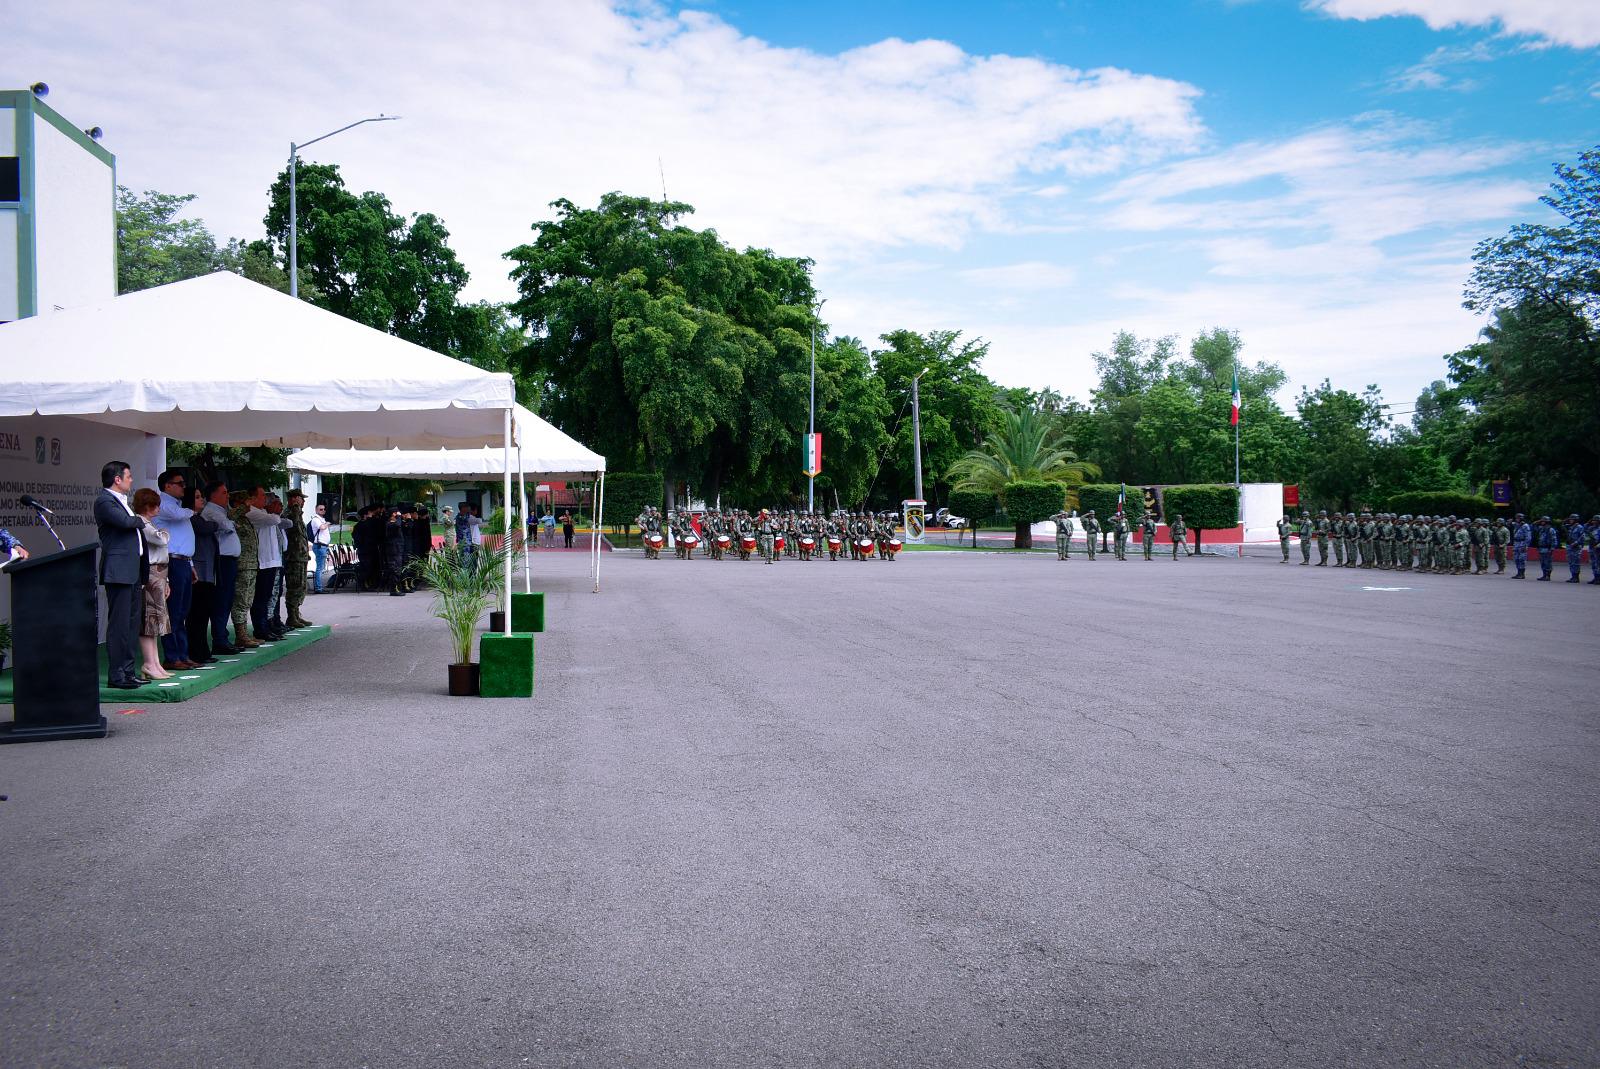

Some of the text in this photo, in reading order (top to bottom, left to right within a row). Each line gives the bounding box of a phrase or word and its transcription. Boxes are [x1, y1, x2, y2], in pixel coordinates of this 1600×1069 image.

[26, 483, 36, 494] DE
[37, 482, 82, 495] DESTRUCCIÓN
[47, 499, 87, 511] DECOMISADO
[56, 515, 83, 526] DEFENSA
